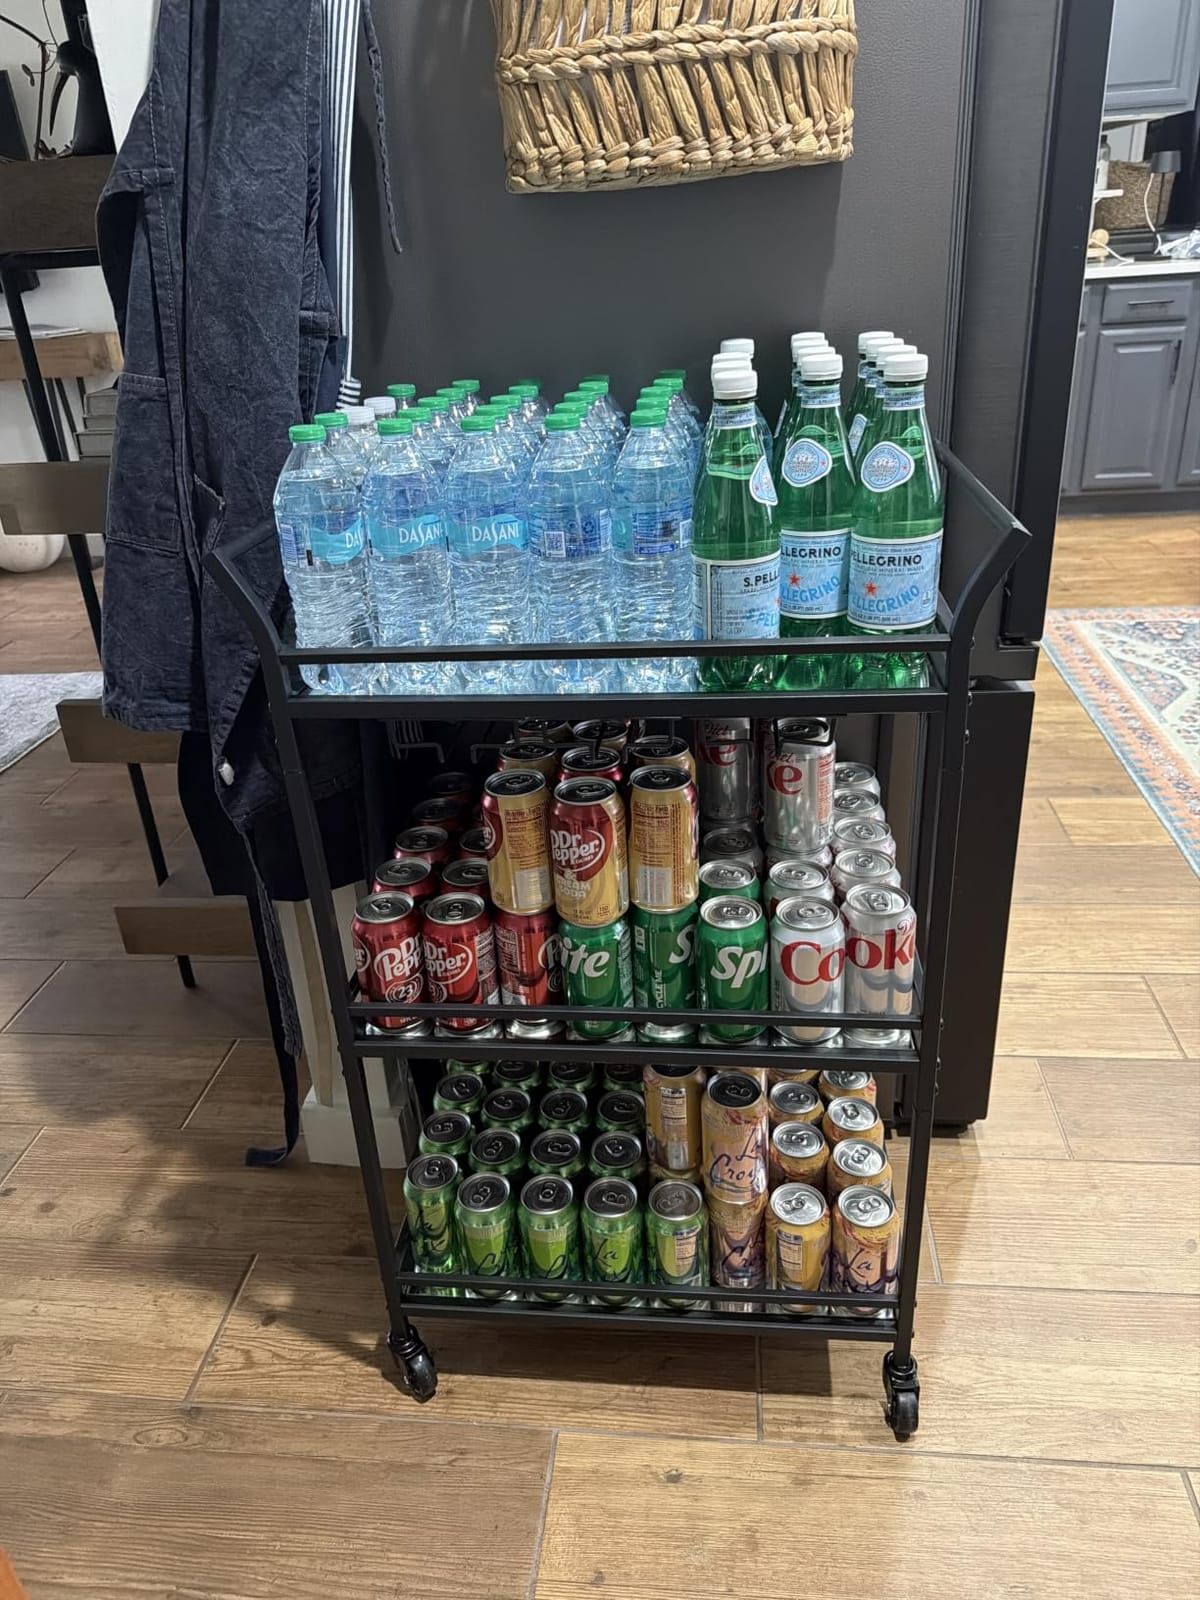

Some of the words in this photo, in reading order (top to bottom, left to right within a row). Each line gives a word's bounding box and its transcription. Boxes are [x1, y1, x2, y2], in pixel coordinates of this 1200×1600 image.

[471, 521, 520, 548] DASANI
[559, 830, 582, 849] Dr
[423, 941, 448, 960] Dr
[399, 983, 414, 999] 23
[592, 1238, 618, 1268] La
[848, 1247, 875, 1279] La
